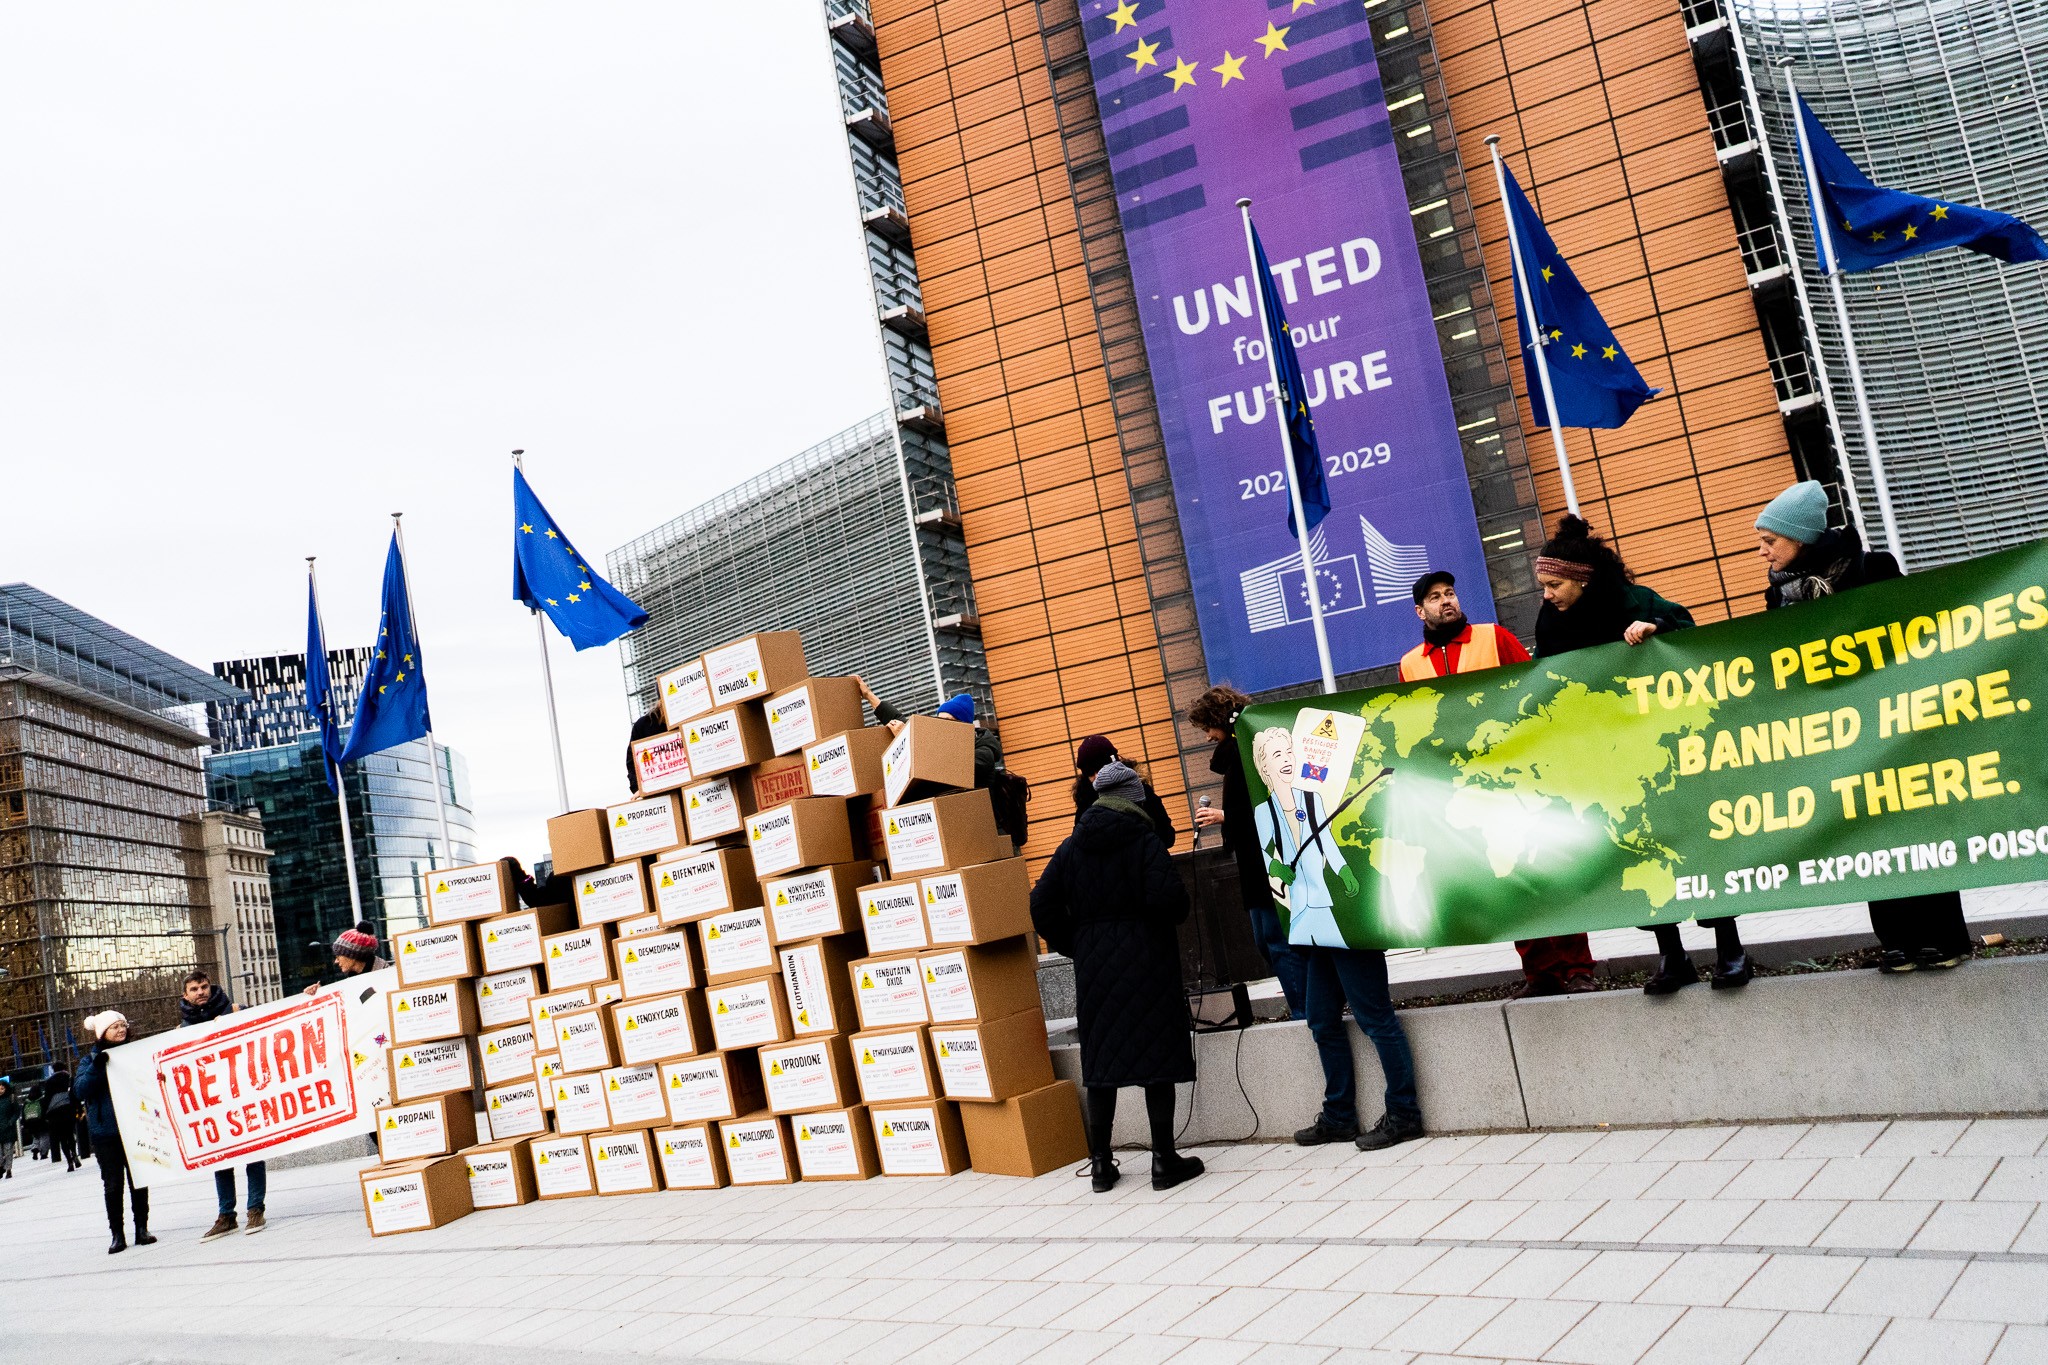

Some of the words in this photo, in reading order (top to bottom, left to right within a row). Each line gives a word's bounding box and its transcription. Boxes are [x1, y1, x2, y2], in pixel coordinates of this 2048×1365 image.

[1173, 237, 1382, 335] UNTED
[1233, 336, 1265, 365] fo
[1290, 315, 1340, 348] our
[1239, 471, 1286, 500] 202
[1326, 443, 1391, 477] 2029
[1626, 656, 1755, 715] TOXIC
[1771, 585, 2048, 690] PESTICIDES
[676, 670, 705, 688] LUFENURO
[691, 686, 708, 696] WARNIN
[718, 678, 748, 695] PROPINEB
[701, 721, 729, 737] PHOSMET
[1678, 706, 1861, 776] BANNED
[1879, 669, 2031, 739] HERE.
[653, 740, 684, 756] SIMAZIN
[717, 737, 735, 748] WARNING
[1303, 737, 1338, 749] PESTICIDES
[644, 751, 684, 766] RETUR
[818, 746, 846, 764] GLUFOSINATE
[1304, 747, 1332, 757] BANNED
[761, 771, 803, 794] RETURN
[764, 794, 773, 803] TO
[775, 788, 804, 801] SENDER
[1708, 786, 1815, 841] SOLD
[1831, 751, 2021, 820] THERE.
[627, 806, 667, 820] PROPARGITE
[759, 816, 790, 832] FAMOXADONE
[898, 813, 932, 828] CYFLUTHRIN
[915, 835, 934, 844] WARNING
[1675, 874, 1715, 900] EU,
[1725, 864, 1789, 894] STOP
[1799, 840, 1957, 886] EXPORTING
[1967, 825, 2048, 864] POISO
[672, 861, 715, 880] BIFENTHRIN
[448, 874, 491, 887] CYPROCONAZOLE
[593, 874, 633, 888] SPIRODICLOFEN
[694, 881, 717, 892] WARNING
[788, 880, 825, 895] NONYLPHENOL
[936, 884, 957, 899] DIQUAT
[789, 889, 825, 903] ETHOXYLATES
[807, 903, 828, 913] WARNING
[877, 896, 914, 911] DICHLOBENIL
[720, 918, 761, 932] AZIMSULFURON
[896, 917, 915, 925] WARNING
[415, 934, 458, 947] FLUFENOXURON
[564, 938, 591, 951] ASULAM
[740, 937, 761, 947] WARNING
[638, 942, 680, 956] DESMEDIPHAM
[658, 960, 681, 970] WARNING
[876, 966, 911, 977] FENBUTATIN
[494, 977, 526, 990] ACETOCHLOR
[788, 955, 803, 1010] CLOTHIANIDIN
[886, 977, 902, 986] OXIDE
[413, 993, 447, 1007] FERBAM
[894, 991, 916, 999] WARNING
[548, 999, 585, 1014] FENAMIPHOS
[637, 1008, 678, 1024] FENOXYCARB
[570, 1022, 596, 1035] BENALAXYL
[657, 1026, 680, 1035] WARNING
[414, 1044, 459, 1058] ETHAMETSULFU
[873, 1046, 914, 1057] ETHOXYSULFURON
[947, 1041, 977, 1051] PROCHLORAZ
[419, 1052, 457, 1064] RON-METHYL
[516, 1049, 535, 1057] WARNIN
[172, 1017, 327, 1114] RETURN
[436, 1064, 461, 1073] WARNING
[551, 1062, 562, 1071] PRO
[782, 1054, 821, 1070] IPRODIONE
[681, 1070, 718, 1082] BROMOXYNIL
[894, 1066, 915, 1075] WARNING
[620, 1072, 653, 1085] CARBENDAZIM
[803, 1075, 824, 1085] WARNING
[500, 1089, 534, 1103] FENAMIPHOS
[574, 1084, 589, 1095] ZINEB
[637, 1090, 656, 1098] WARNING
[699, 1088, 720, 1097] WARNING
[189, 1117, 221, 1148] TO
[226, 1079, 336, 1136] SENDER
[399, 1110, 435, 1124] PROPANIL
[809, 1124, 845, 1135] IMIDACLOPRID
[892, 1121, 930, 1132] PENCYCURON
[739, 1129, 774, 1142] THIACLOPRID
[548, 1148, 579, 1159] PYMETROZINE
[608, 1144, 639, 1157] FIPRONIL
[828, 1144, 847, 1152] WARNING
[758, 1151, 776, 1159] WARNING
